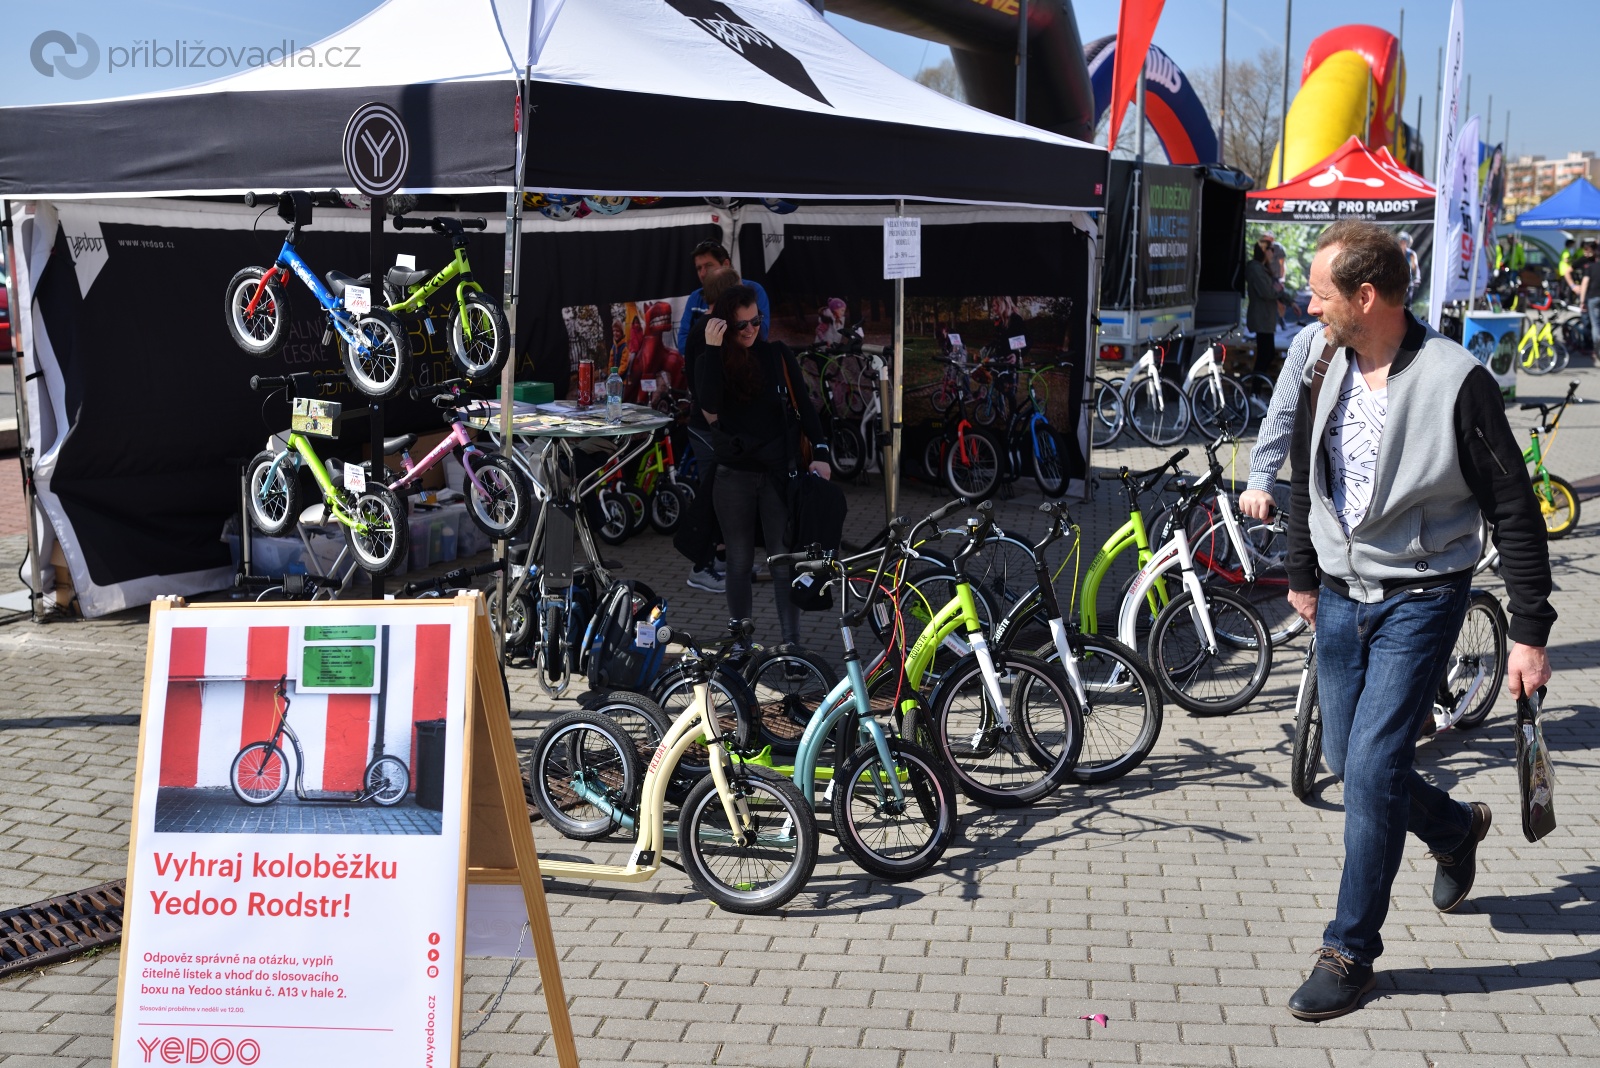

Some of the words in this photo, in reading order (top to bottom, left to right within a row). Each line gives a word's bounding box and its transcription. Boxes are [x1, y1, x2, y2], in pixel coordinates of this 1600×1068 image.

[1338, 201, 1364, 213] PRO
[1366, 200, 1419, 213] RADOST
[1128, 569, 1148, 595] DRAGSTR
[910, 633, 928, 660] RODSTR
[648, 742, 668, 774] FRIDAY
[153, 851, 243, 882] Vyhraj
[252, 852, 397, 879] koloběžku
[150, 890, 237, 916] Yedoo
[247, 891, 351, 918] Rodstr!
[144, 952, 192, 964] Odpověz
[195, 953, 239, 965] správně
[243, 956, 255, 964] na
[259, 954, 299, 966] otázku,
[303, 955, 333, 967] vyplň
[142, 968, 180, 978] čitelně
[183, 969, 212, 979] lístek
[225, 970, 254, 980] vhoď
[255, 971, 269, 980] do
[272, 971, 339, 982] slosovacího
[141, 984, 168, 994] boxu
[172, 986, 184, 994] na
[188, 985, 222, 995] Yedoo
[225, 986, 262, 996] stánku
[265, 987, 274, 996] č.
[278, 987, 298, 997] A13
[310, 988, 334, 998] hale
[337, 989, 347, 998] 2.
